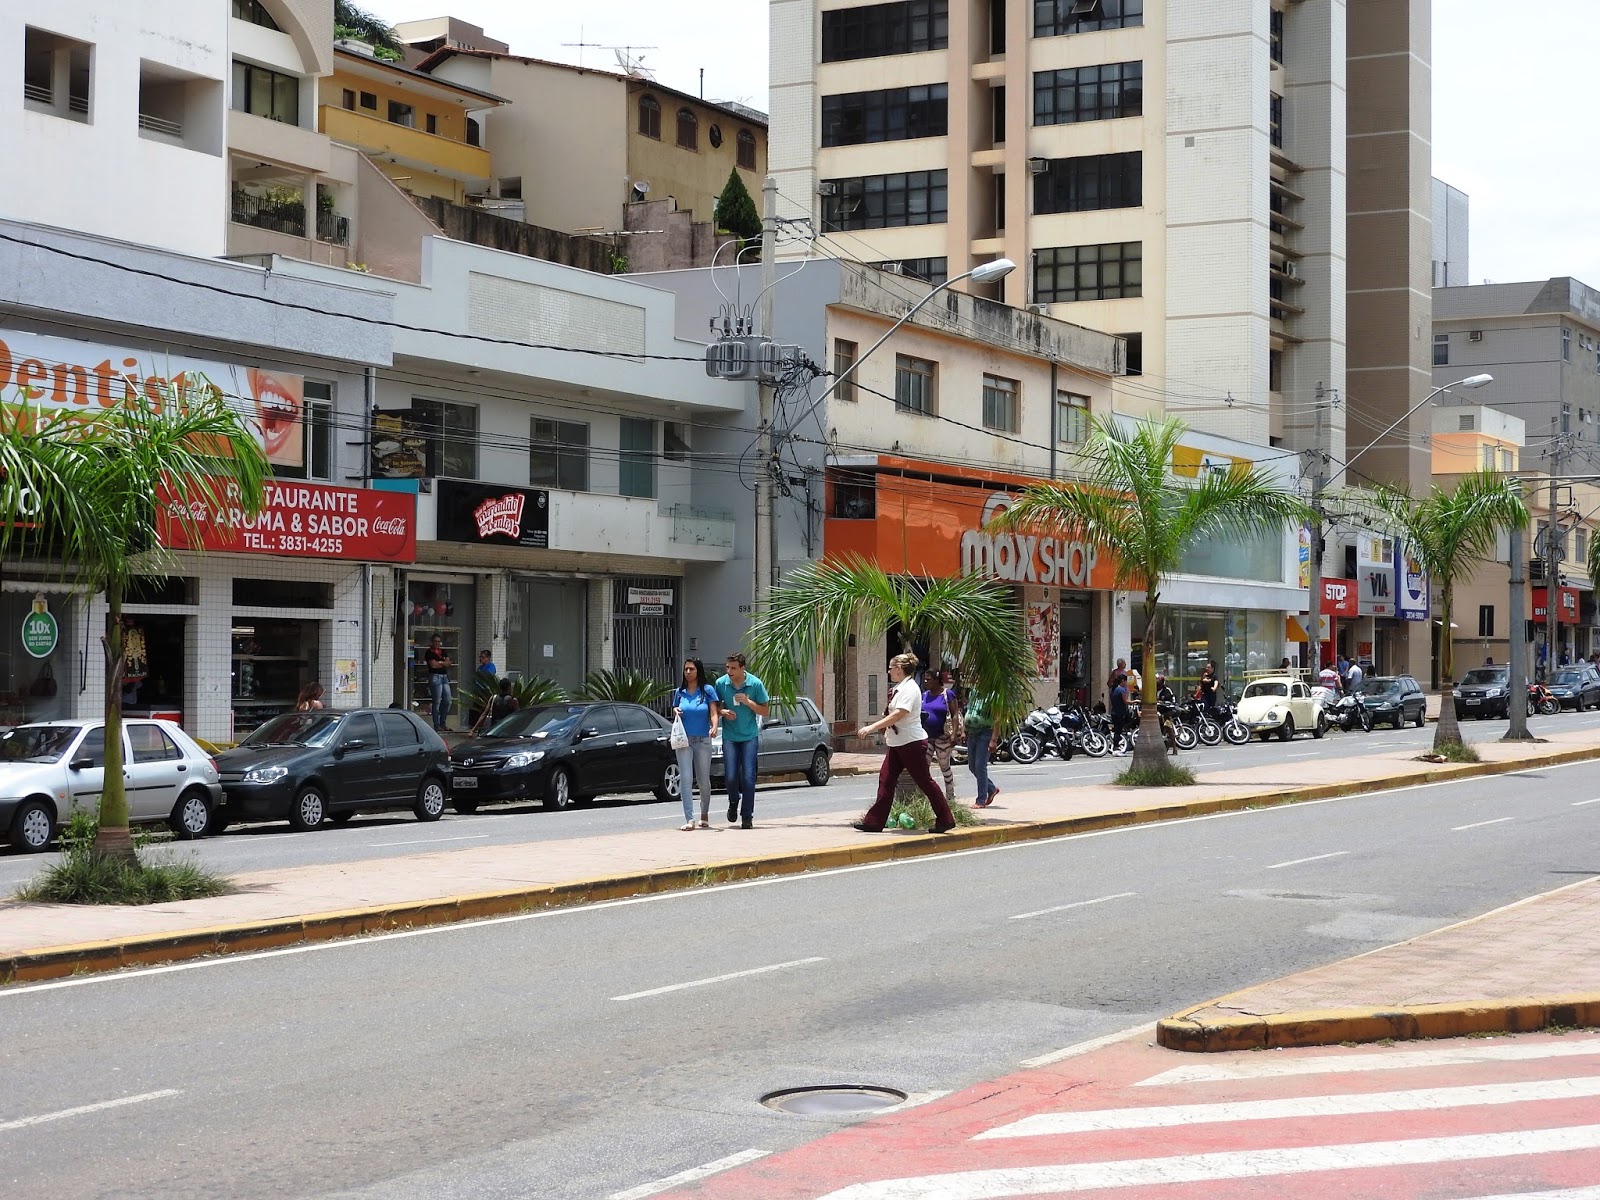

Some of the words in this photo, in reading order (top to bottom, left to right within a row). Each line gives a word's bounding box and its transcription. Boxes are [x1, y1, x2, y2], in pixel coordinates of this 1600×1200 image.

[0, 338, 224, 418] entist
[226, 482, 358, 513] RTAURANTE
[213, 506, 286, 532] AROMA
[290, 512, 303, 533] &
[308, 514, 369, 538] SABOR
[243, 532, 275, 550] TEL.:
[279, 535, 343, 553] 3831-4255
[1325, 583, 1347, 601] STOP
[1534, 607, 1547, 616] Bli
[29, 620, 51, 635] 10x
